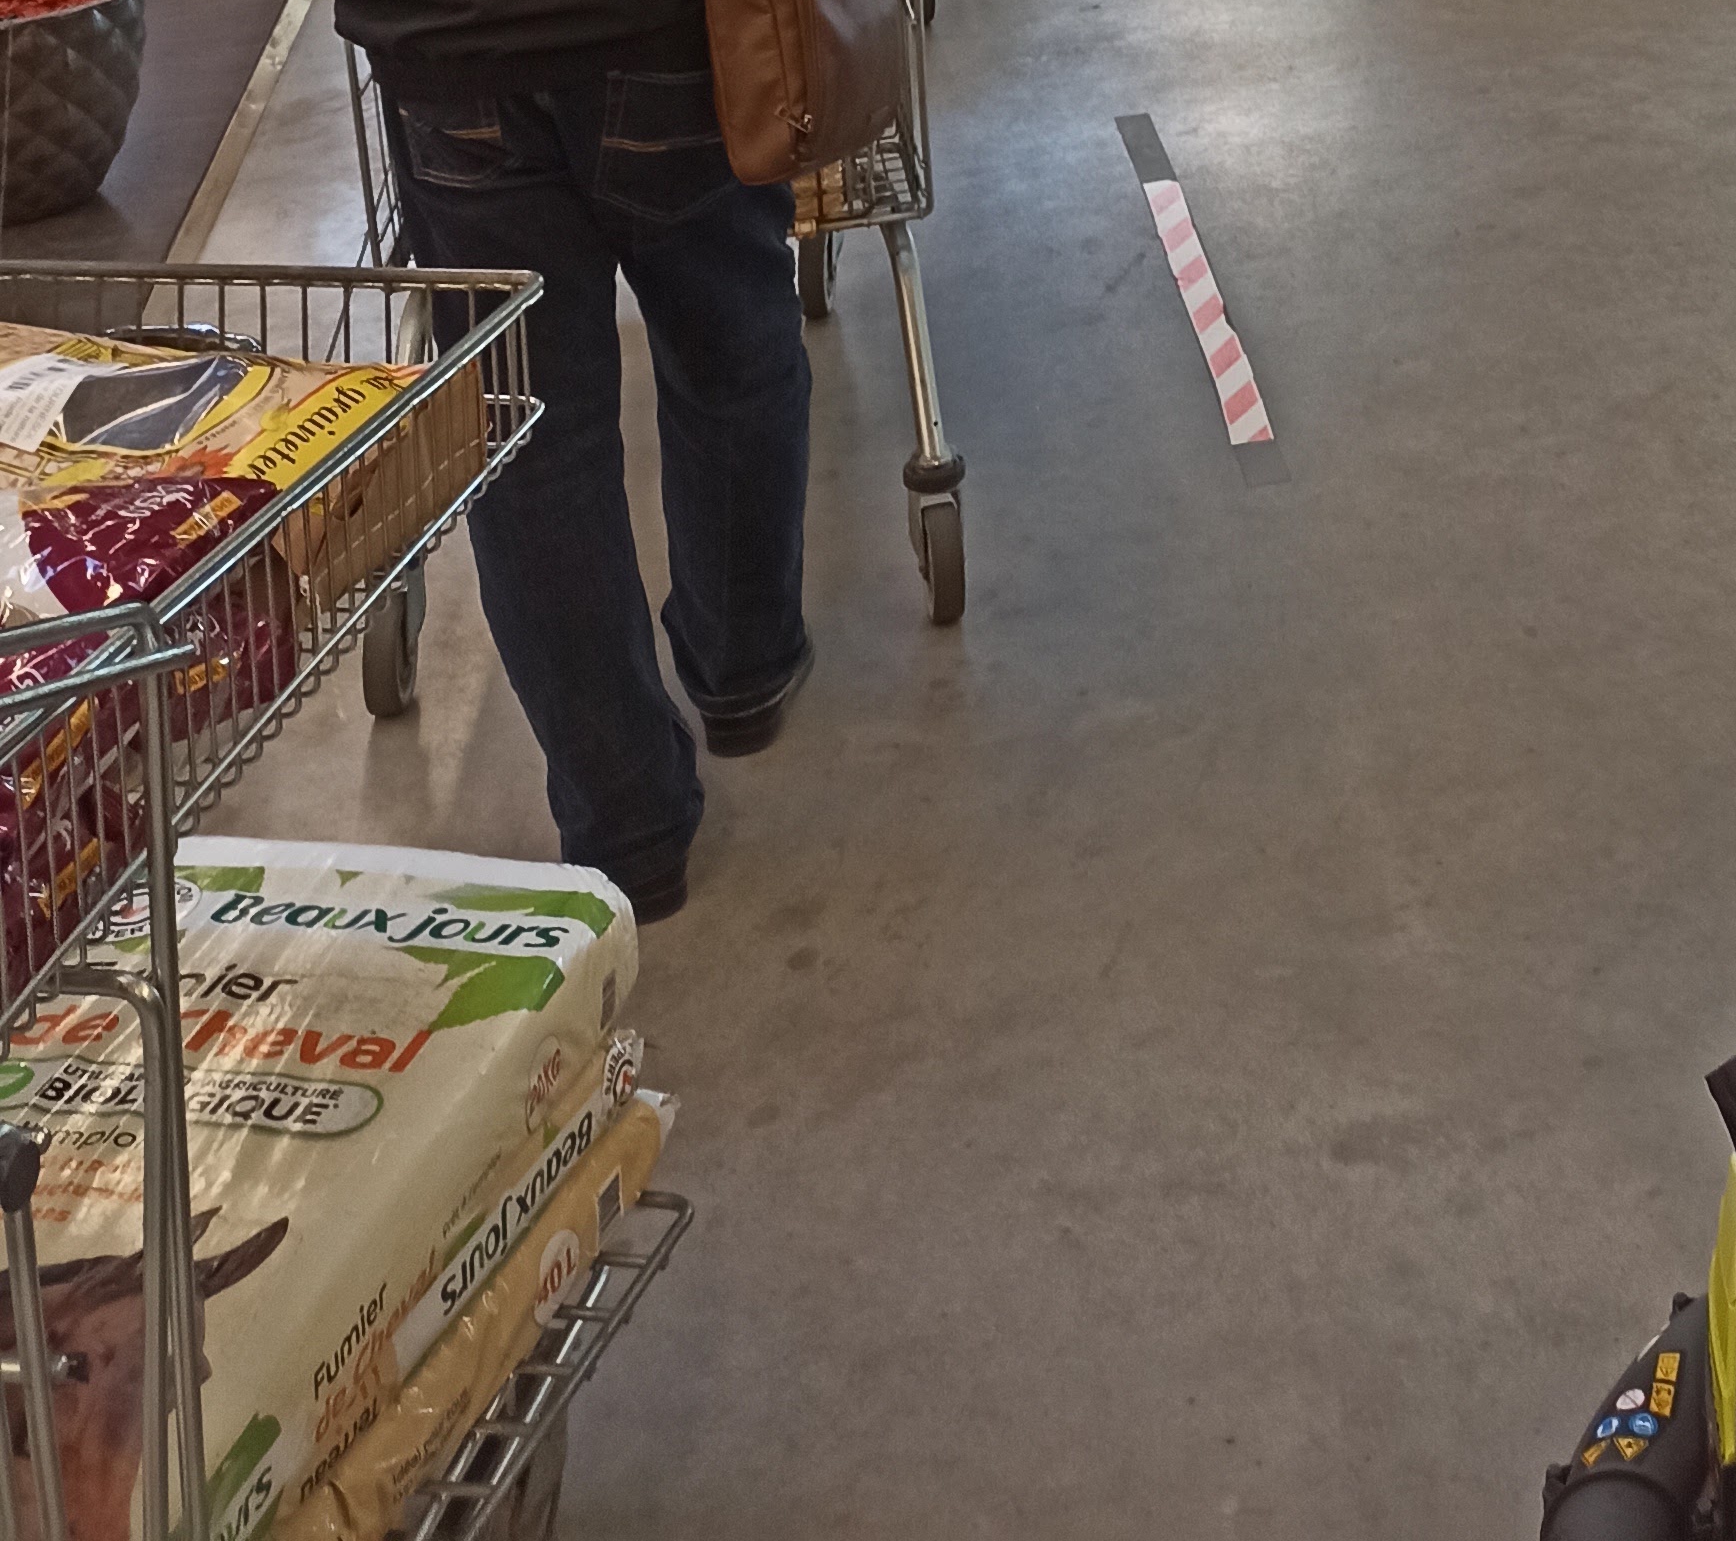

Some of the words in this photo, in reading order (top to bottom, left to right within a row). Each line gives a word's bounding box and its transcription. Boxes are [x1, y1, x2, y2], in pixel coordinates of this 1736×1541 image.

[210, 893, 406, 933] Beaux
[387, 907, 570, 948] jours
[178, 1007, 433, 1073] heval
[37, 1075, 331, 1126] BIOLGIQUE
[515, 1110, 593, 1227] Beaux
[440, 1195, 514, 1317] jours
[313, 1282, 388, 1402] Fumier
